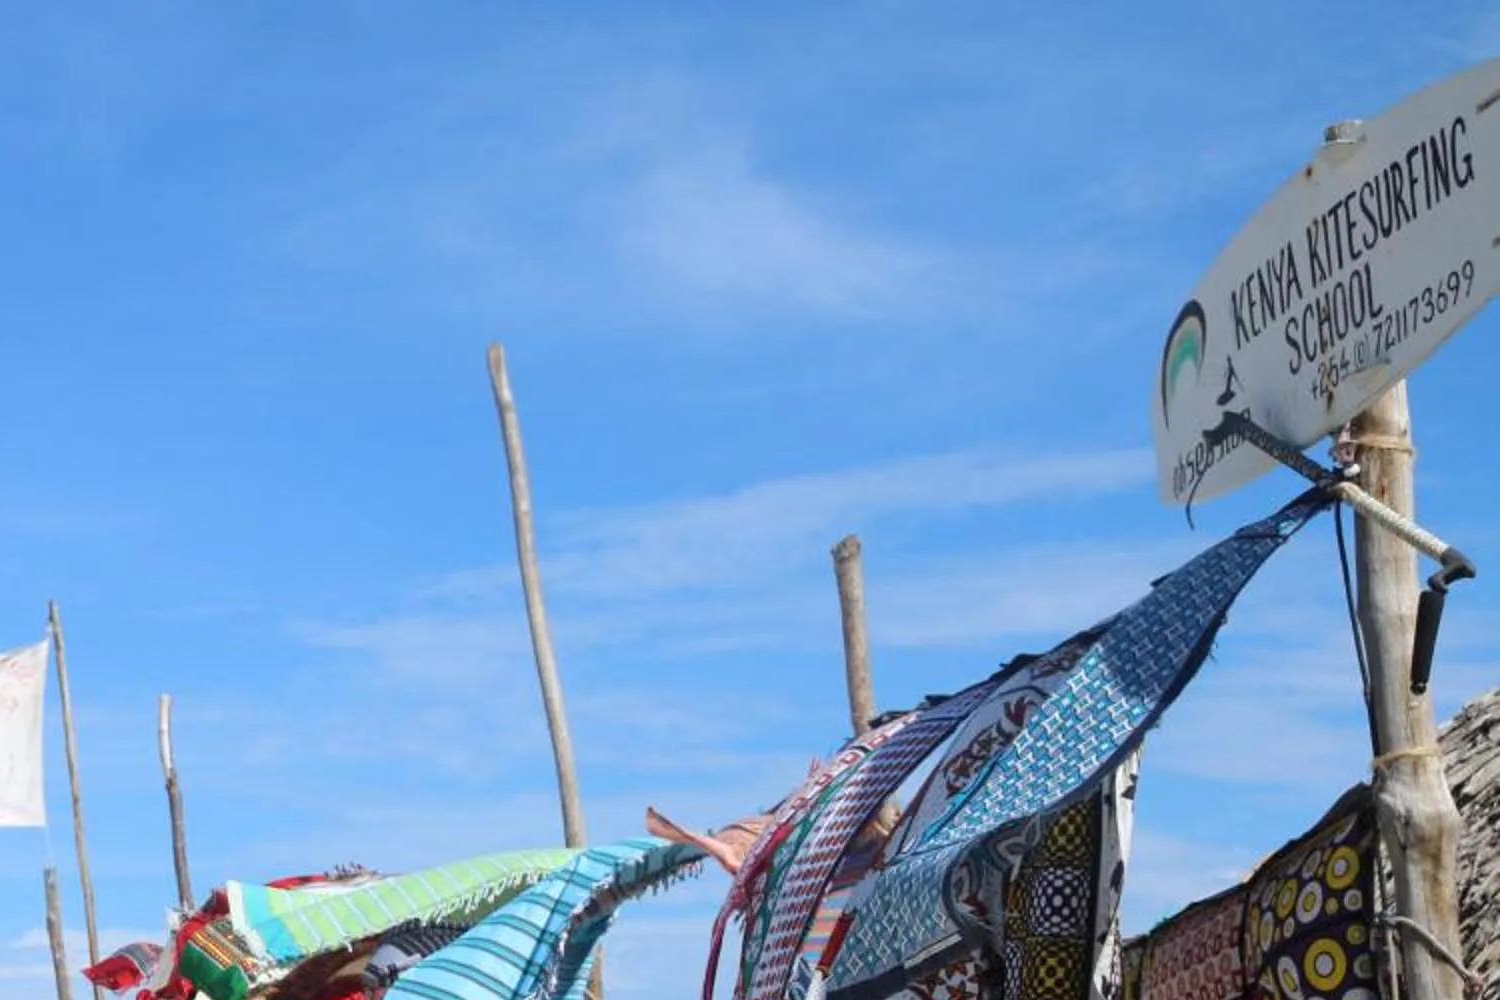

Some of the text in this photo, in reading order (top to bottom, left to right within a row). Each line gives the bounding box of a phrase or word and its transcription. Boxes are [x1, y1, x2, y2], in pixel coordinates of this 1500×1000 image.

[1231, 116, 1474, 350] KENYA KITESURFING
[1285, 262, 1383, 375] SCHOOL
[1372, 260, 1475, 357] 721173699
